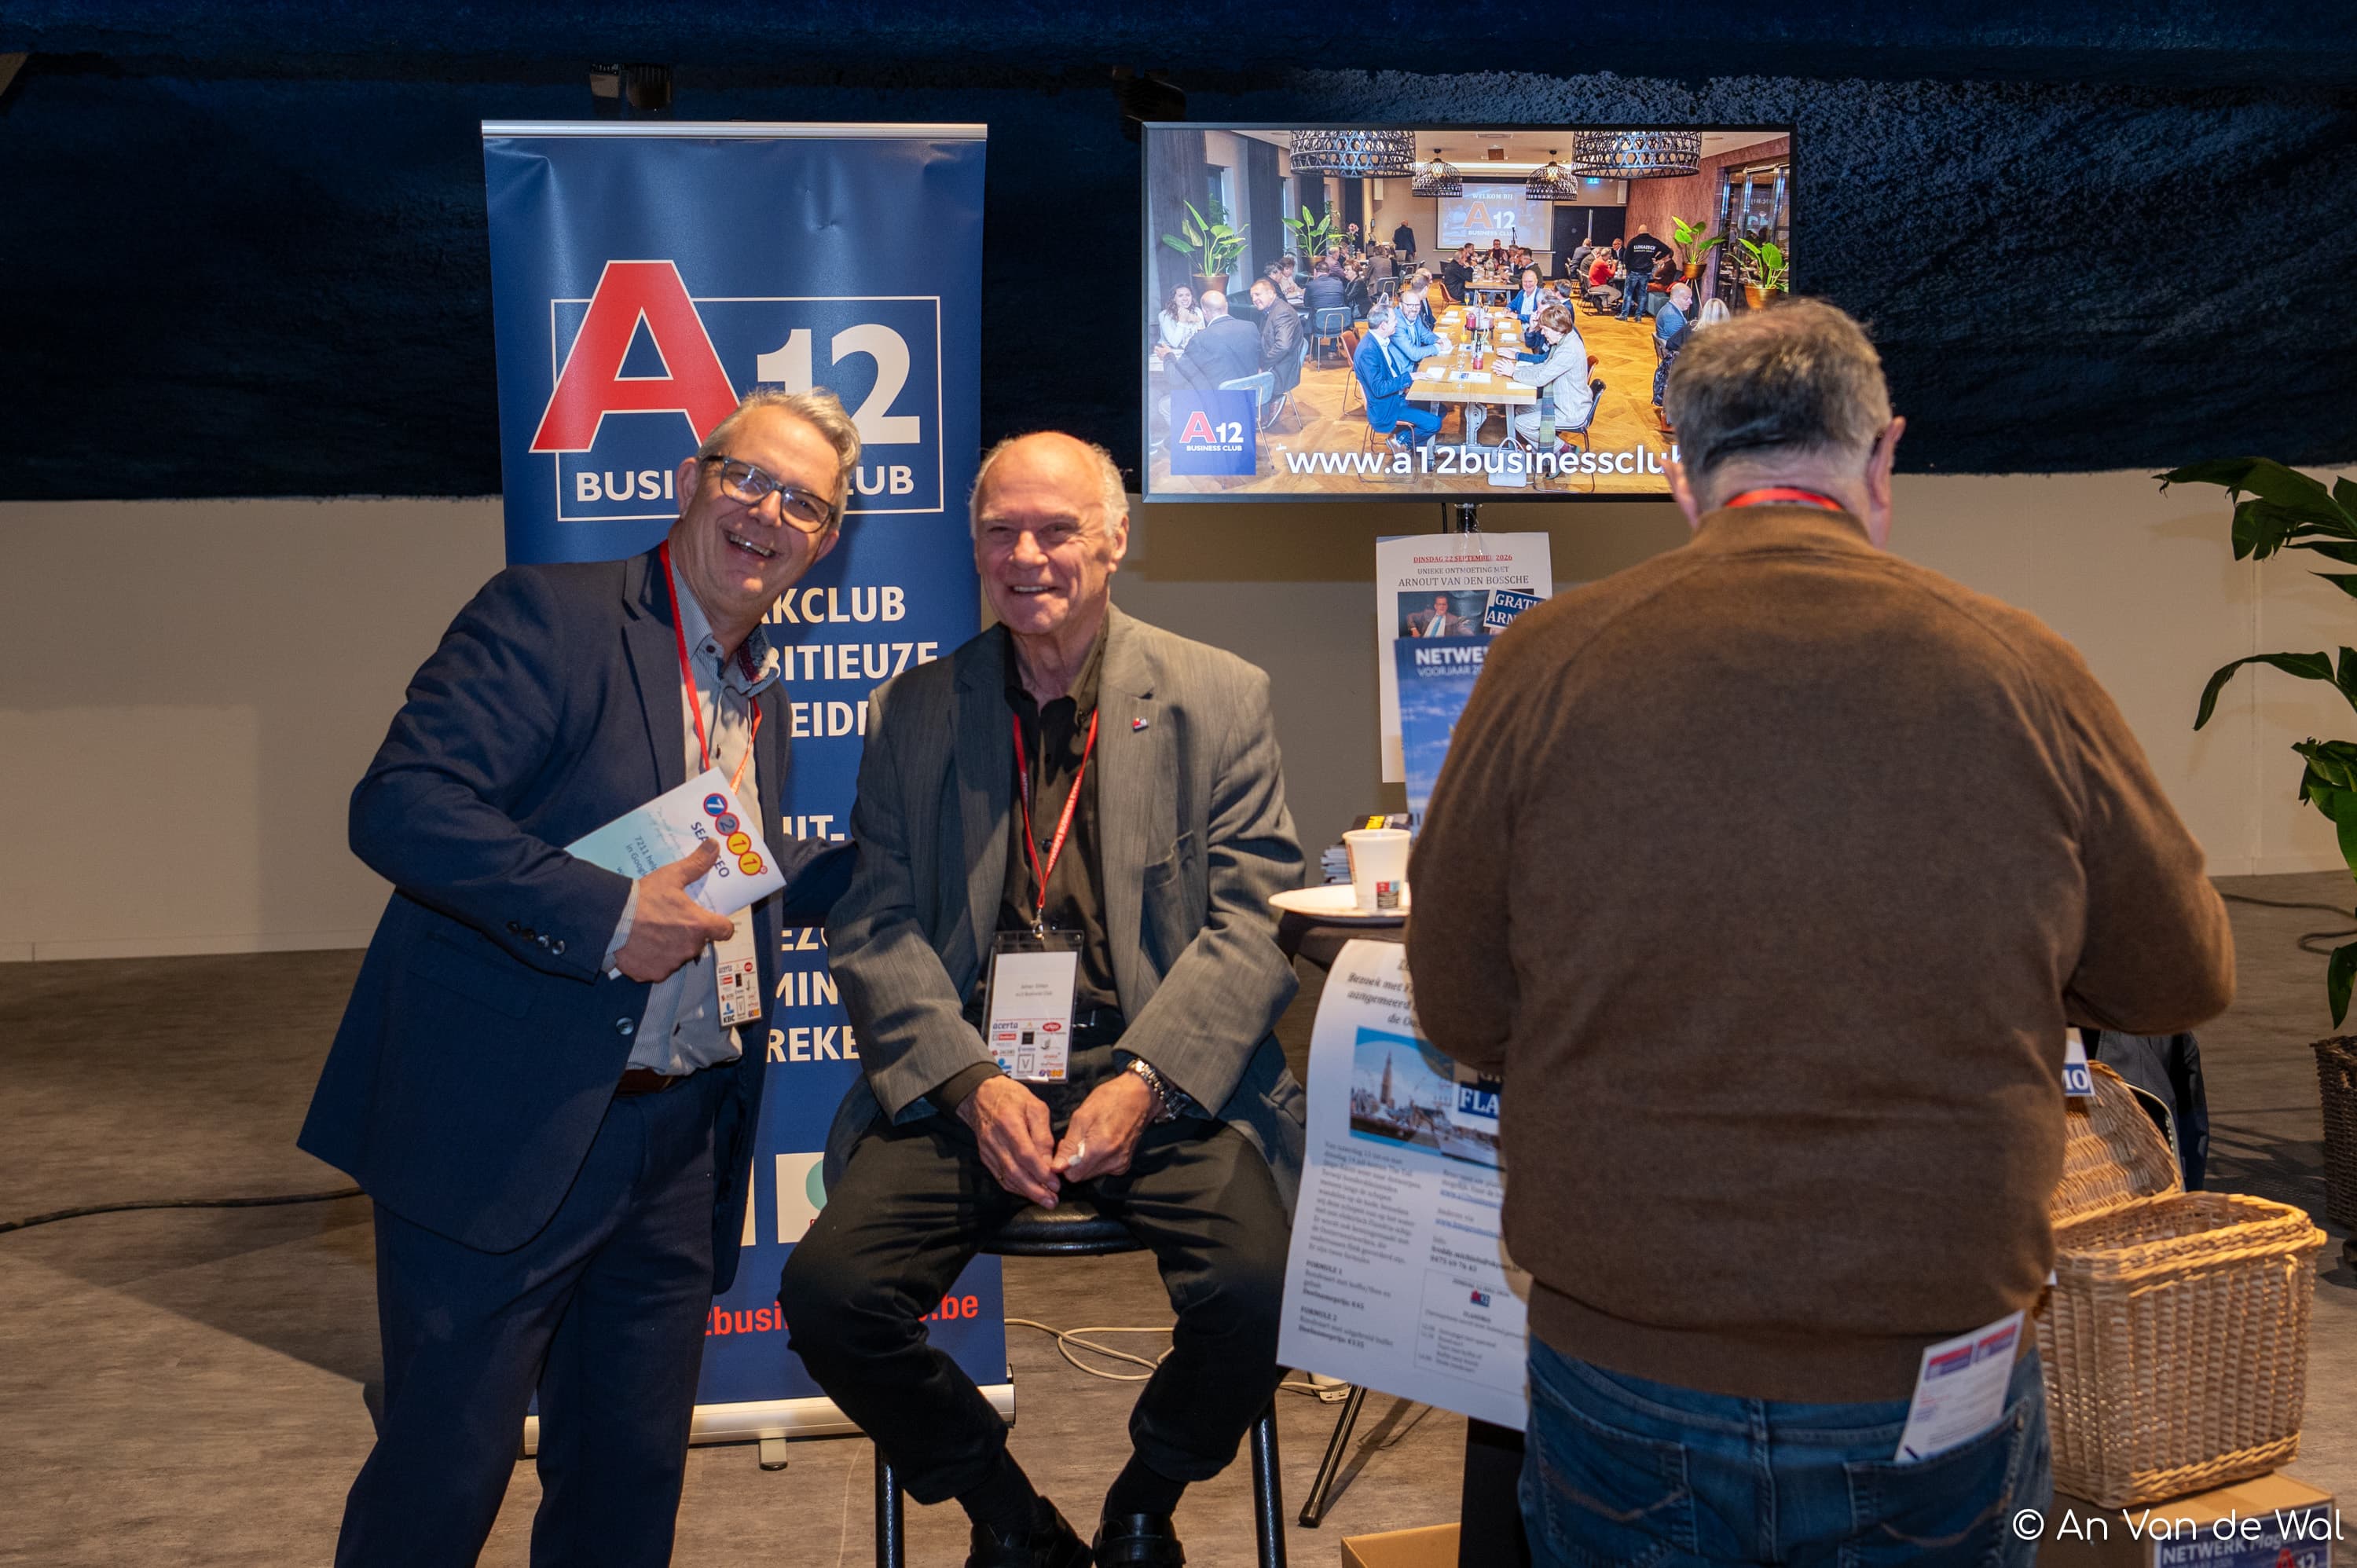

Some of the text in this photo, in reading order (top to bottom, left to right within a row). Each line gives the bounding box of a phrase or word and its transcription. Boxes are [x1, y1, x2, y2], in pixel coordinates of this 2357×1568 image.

[1463, 201, 1516, 229] A12
[528, 259, 921, 453] A12
[1178, 410, 1244, 444] A12
[1285, 444, 1682, 474] www.a12businessclu
[576, 470, 673, 501] BUSI
[1398, 574, 1530, 588] ARNOUT VAN DEN BOSSCHE
[1417, 566, 1444, 575] UNIEKE
[1486, 610, 1517, 625] ARN
[992, 1021, 1019, 1030] acerta
[1460, 1086, 1500, 1116] FLA
[705, 1293, 979, 1336] busi .be
[2162, 1537, 2246, 1566] NETWERK
